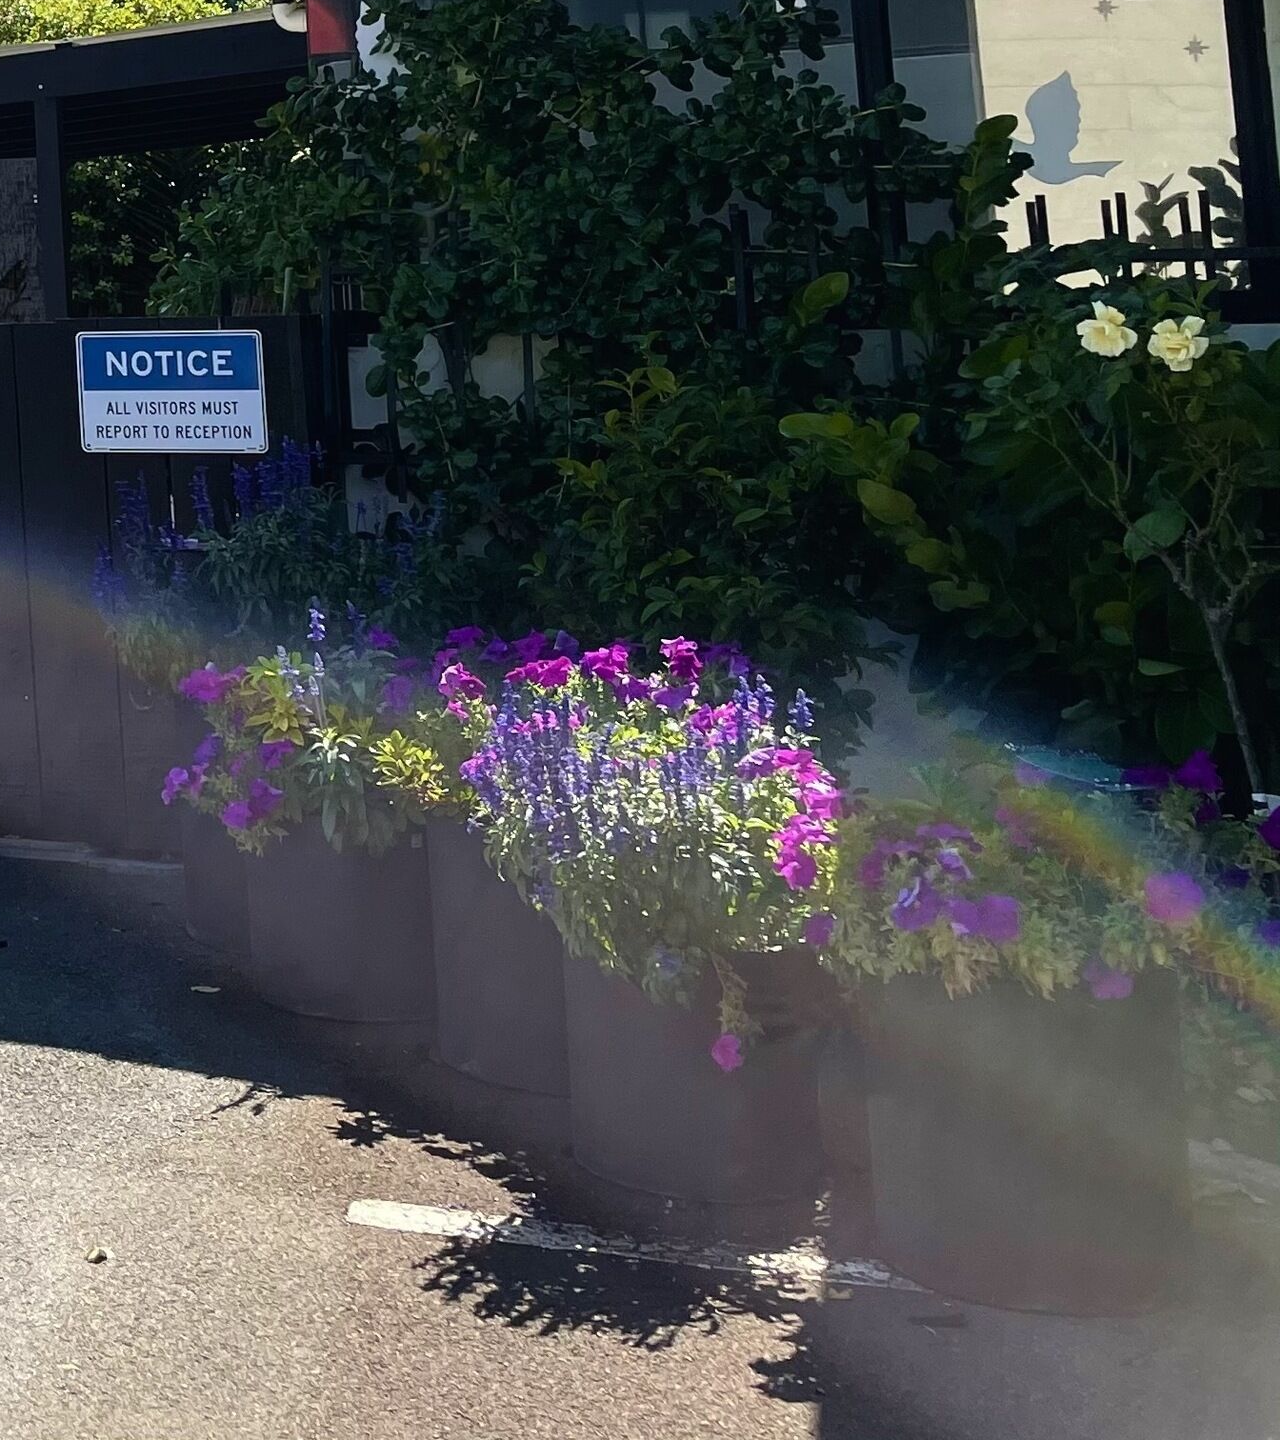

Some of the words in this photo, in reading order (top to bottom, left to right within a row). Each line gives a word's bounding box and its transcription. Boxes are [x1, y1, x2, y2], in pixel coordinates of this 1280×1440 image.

[105, 349, 234, 377] NOTICE
[106, 401, 131, 415] ALL
[135, 401, 196, 415] VISITORS
[202, 401, 239, 415] MUST
[96, 425, 148, 439] REPORT
[153, 425, 170, 439] TO
[175, 425, 252, 439] RECEPTION
